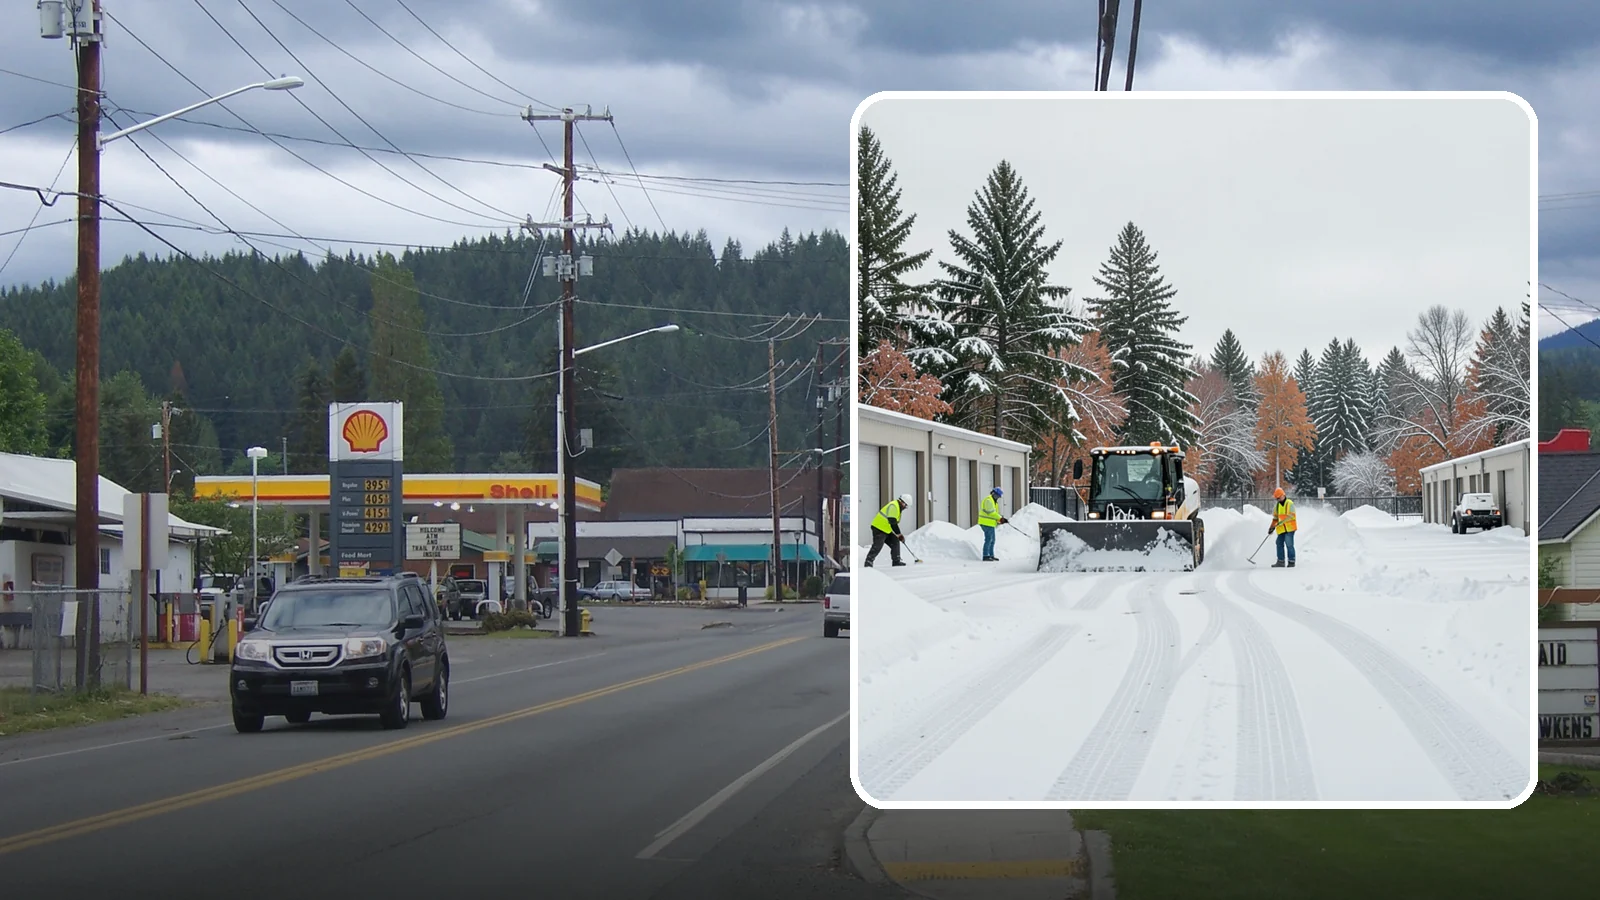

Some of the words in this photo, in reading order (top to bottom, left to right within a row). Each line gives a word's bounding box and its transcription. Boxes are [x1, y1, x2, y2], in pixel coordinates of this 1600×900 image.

[365, 480, 384, 490] 395
[490, 484, 547, 499] Shell
[365, 494, 384, 504] 405
[365, 508, 384, 518] 415
[365, 522, 384, 532] 429
